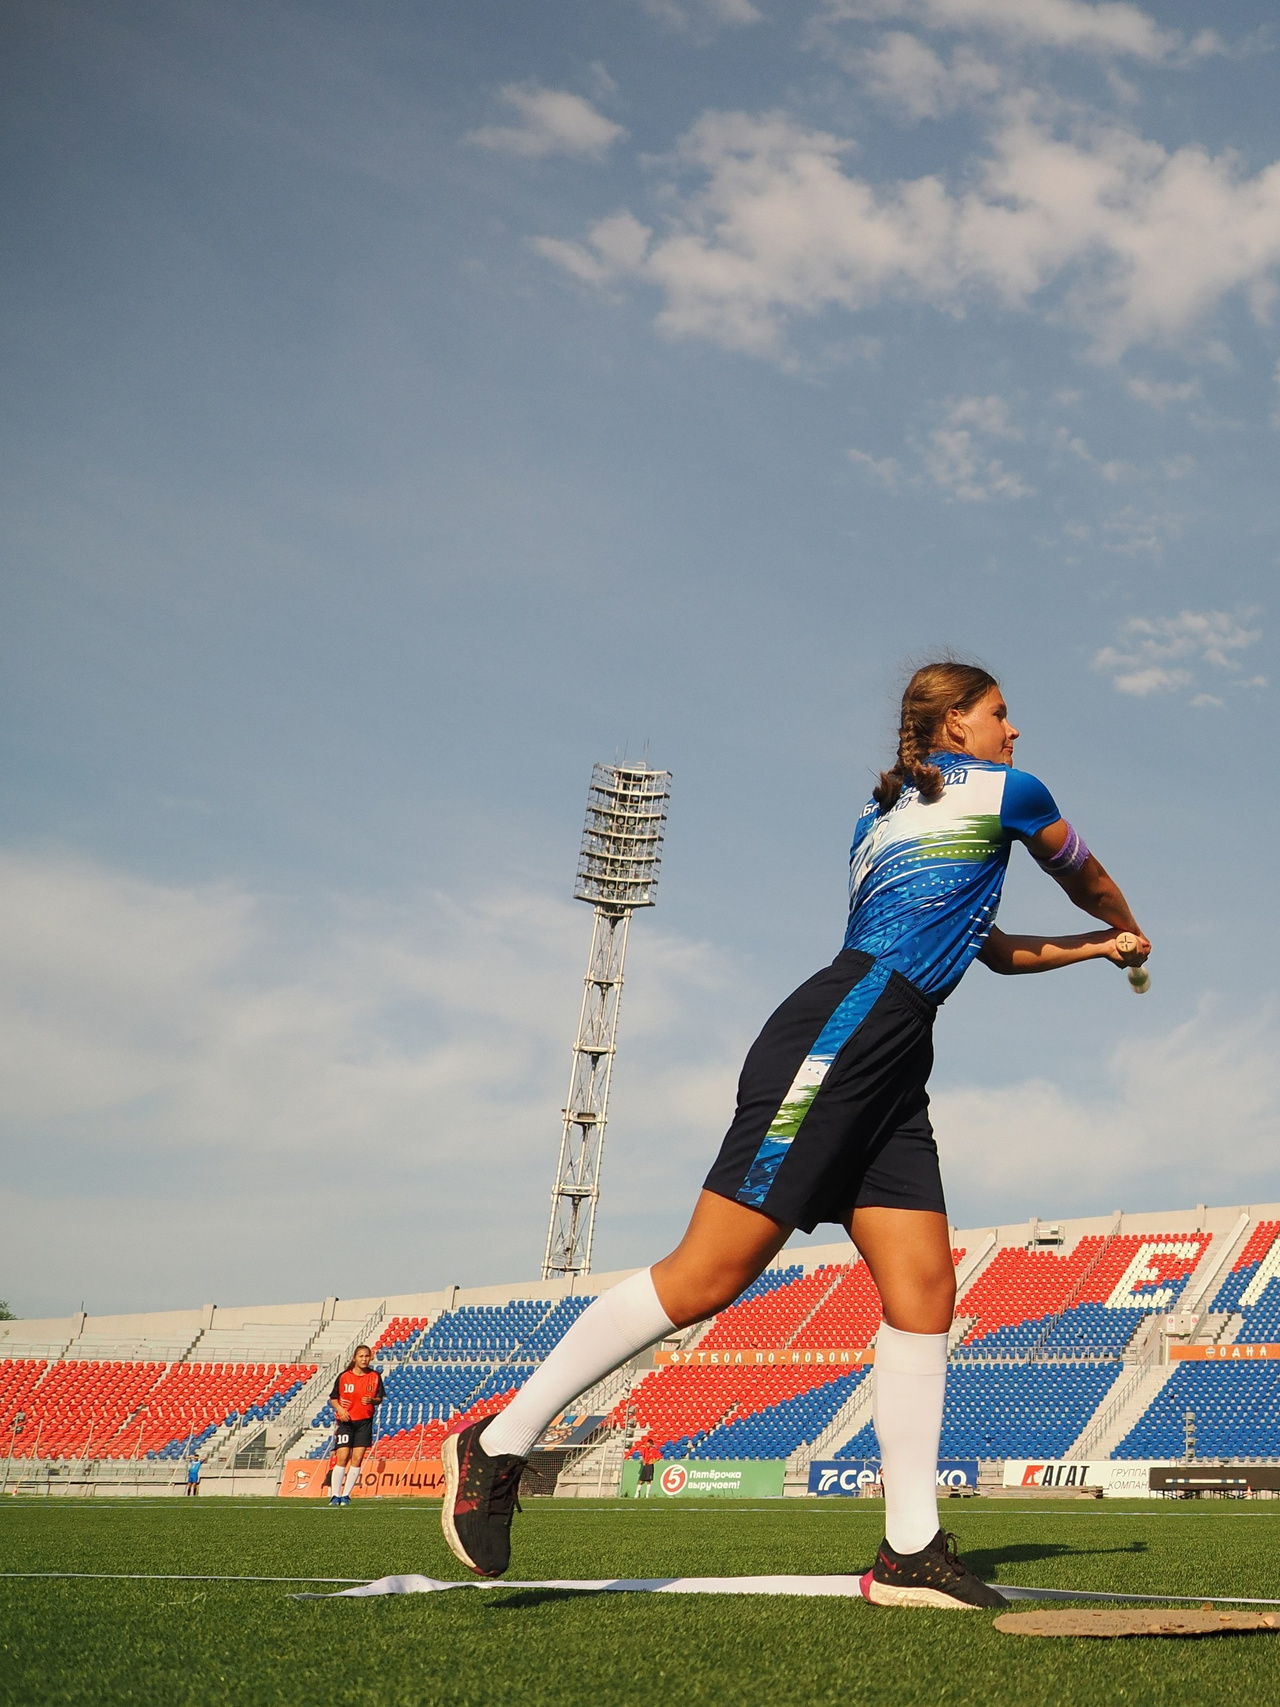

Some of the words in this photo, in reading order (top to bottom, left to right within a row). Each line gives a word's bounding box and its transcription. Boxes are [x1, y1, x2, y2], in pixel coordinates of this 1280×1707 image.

[670, 1351, 742, 1363] ФУТБОЛ
[756, 1351, 863, 1363] ПО-НОВОМУ
[1220, 1345, 1267, 1358] ОДНА
[344, 1383, 355, 1393] 10
[337, 1434, 349, 1444] 10
[689, 1469, 742, 1481] Пятёрочка
[1041, 1465, 1090, 1486] АГАТ
[1111, 1468, 1147, 1477] ГРУППА
[687, 1480, 741, 1491] выручает!
[1108, 1480, 1149, 1490] КОМПАН
